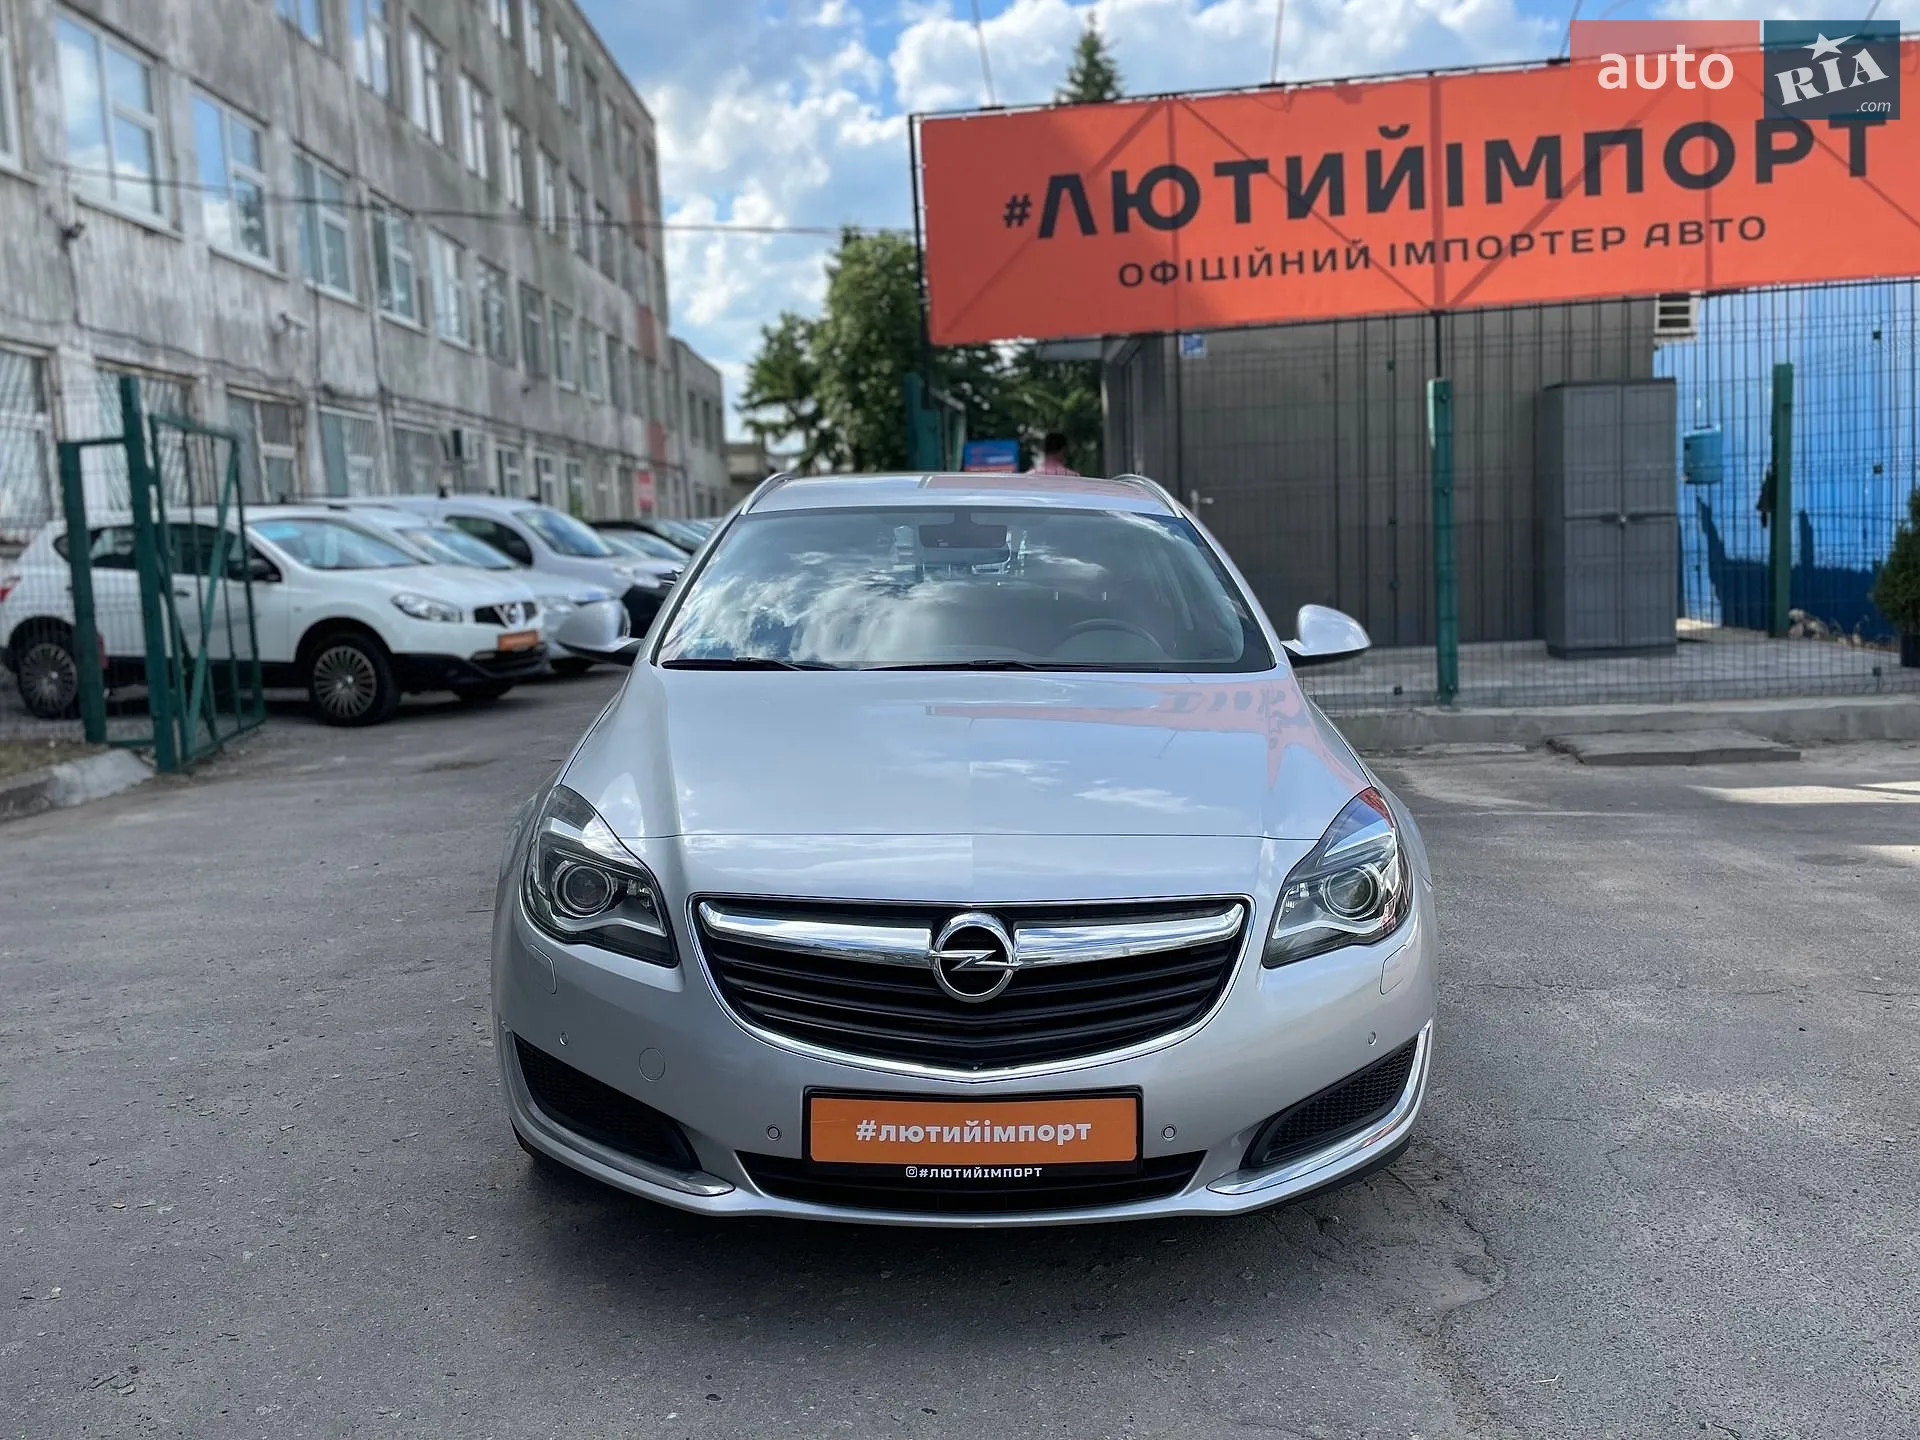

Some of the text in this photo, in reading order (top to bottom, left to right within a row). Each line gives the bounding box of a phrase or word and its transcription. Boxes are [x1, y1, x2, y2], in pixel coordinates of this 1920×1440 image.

[1003, 113, 1887, 239] #ЛЮТИЙІМПОРТ
[1118, 216, 1767, 288] ОФІЦІЙНИЙ ІМПОРТЕР АВТО
[856, 1118, 1092, 1146] #лютийімпорт
[919, 1166, 1042, 1178] #ЛЮТИЙІМПОРТ
